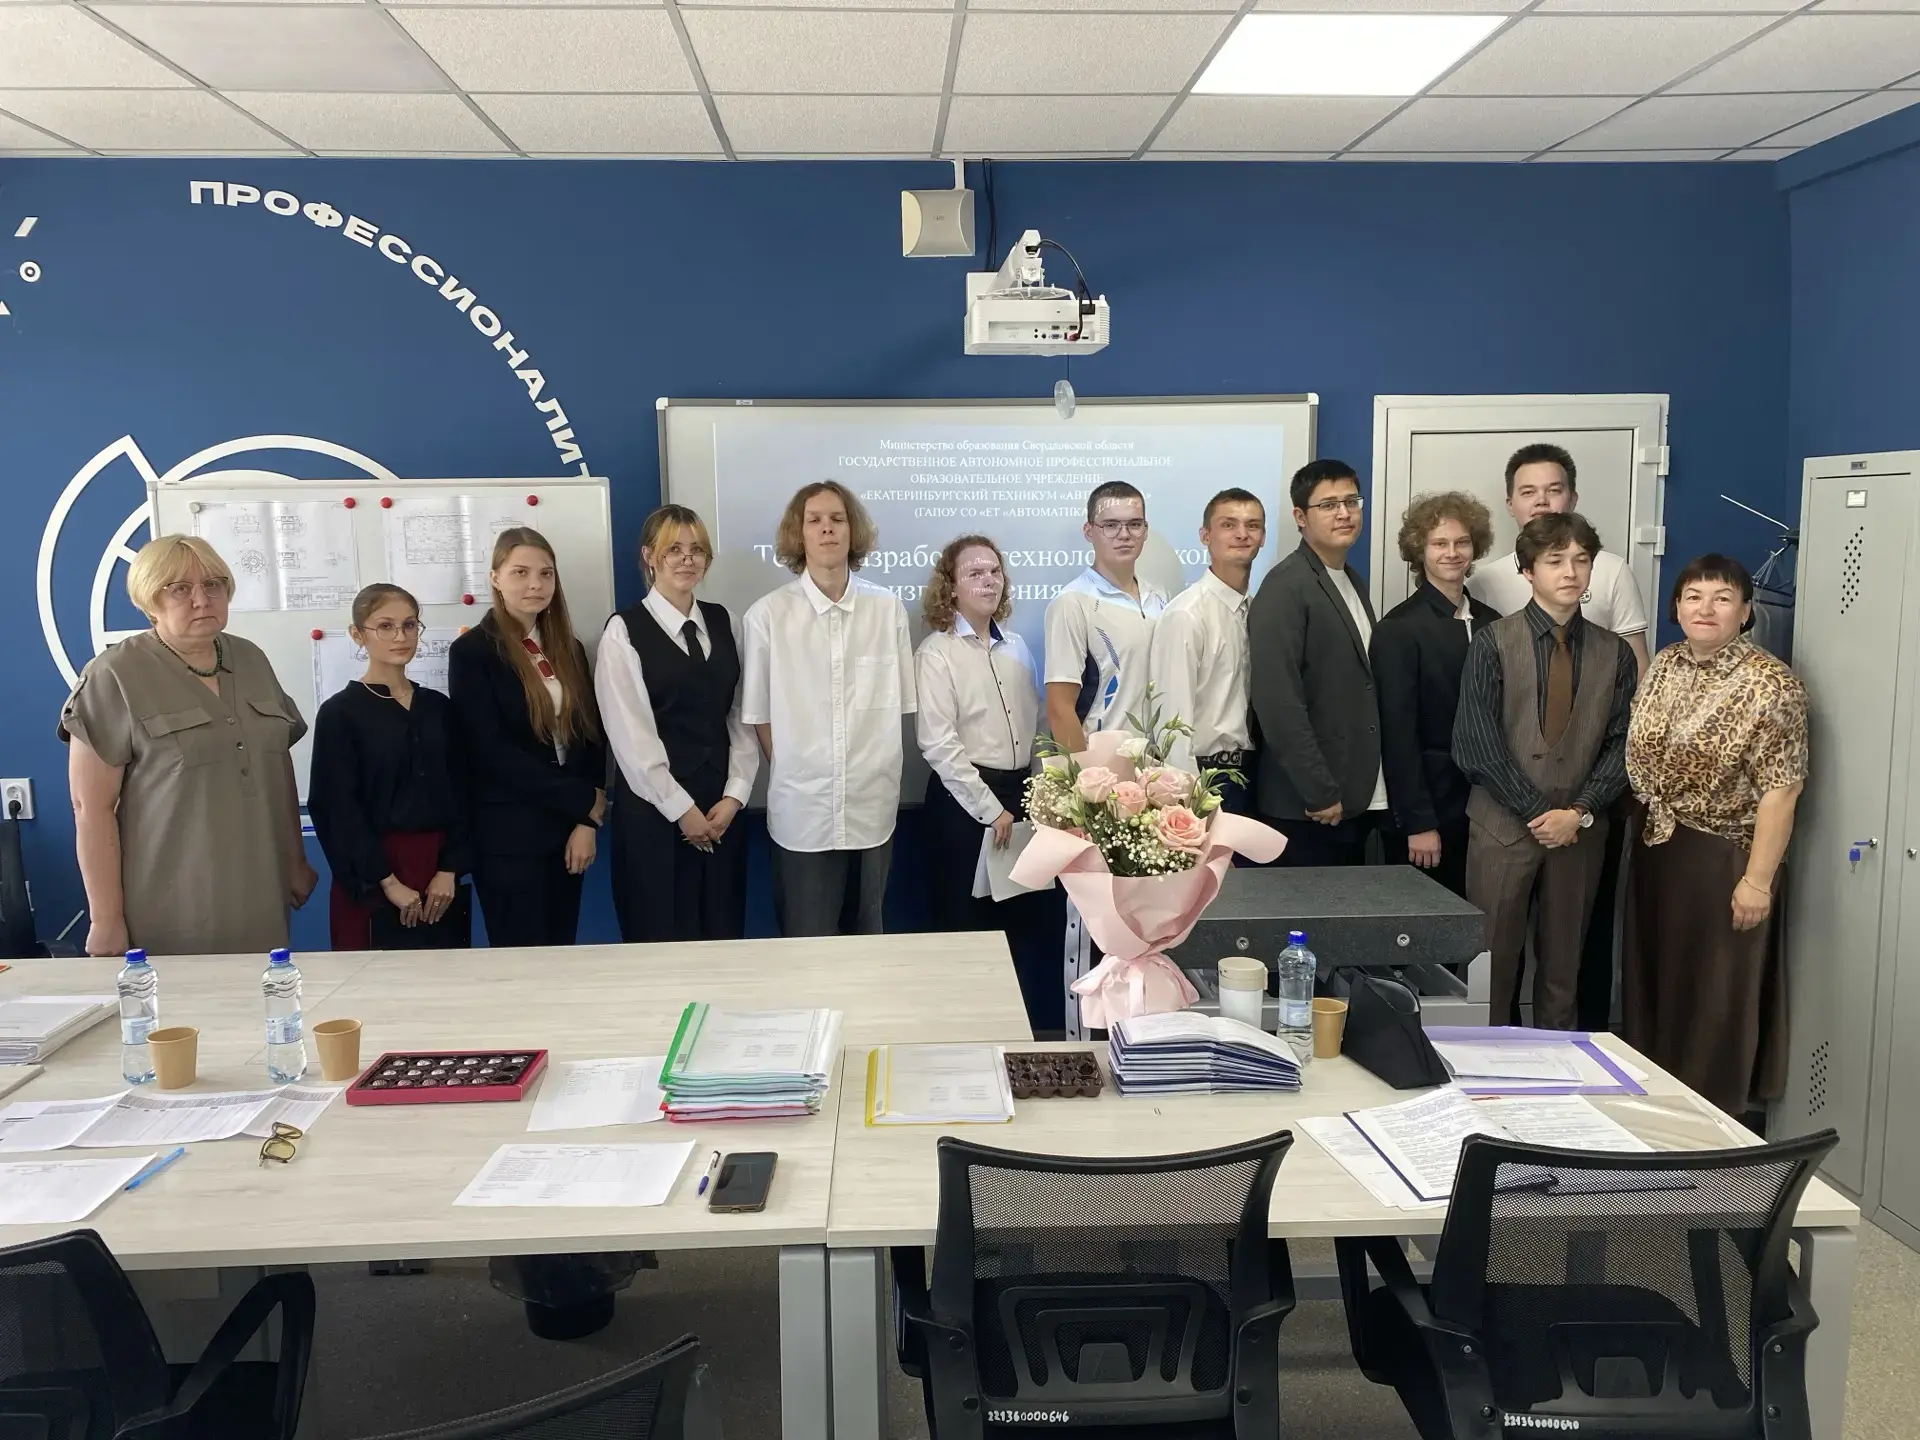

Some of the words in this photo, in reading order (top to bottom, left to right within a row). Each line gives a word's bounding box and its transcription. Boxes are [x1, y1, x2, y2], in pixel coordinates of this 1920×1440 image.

[880, 439, 954, 452] Министерство
[956, 440, 1019, 452] образования
[1022, 440, 1093, 452] Свердловской
[1095, 440, 1134, 450] области
[838, 456, 956, 468] ГОСУДАРСТВЕННОЕ
[959, 456, 1043, 467] АВТОНОМНОЕ
[1046, 456, 1173, 467] ПРОФЕССИОНАЛЬНОЕ
[910, 473, 1021, 484] ОБРАЗОВАТЕЛЬНОЕ
[1025, 473, 1104, 484] УЧРЕЖДЕНИЕ
[860, 488, 988, 501] «ЕКАТЕРИНБУРГСКИЙ
[991, 490, 1057, 501] ТЕХНИКУМ
[914, 507, 958, 519] (ГАПОУ
[960, 507, 977, 517] СО
[979, 508, 1000, 517] «ЕТ
[988, 1410, 1069, 1423] 221360000646
